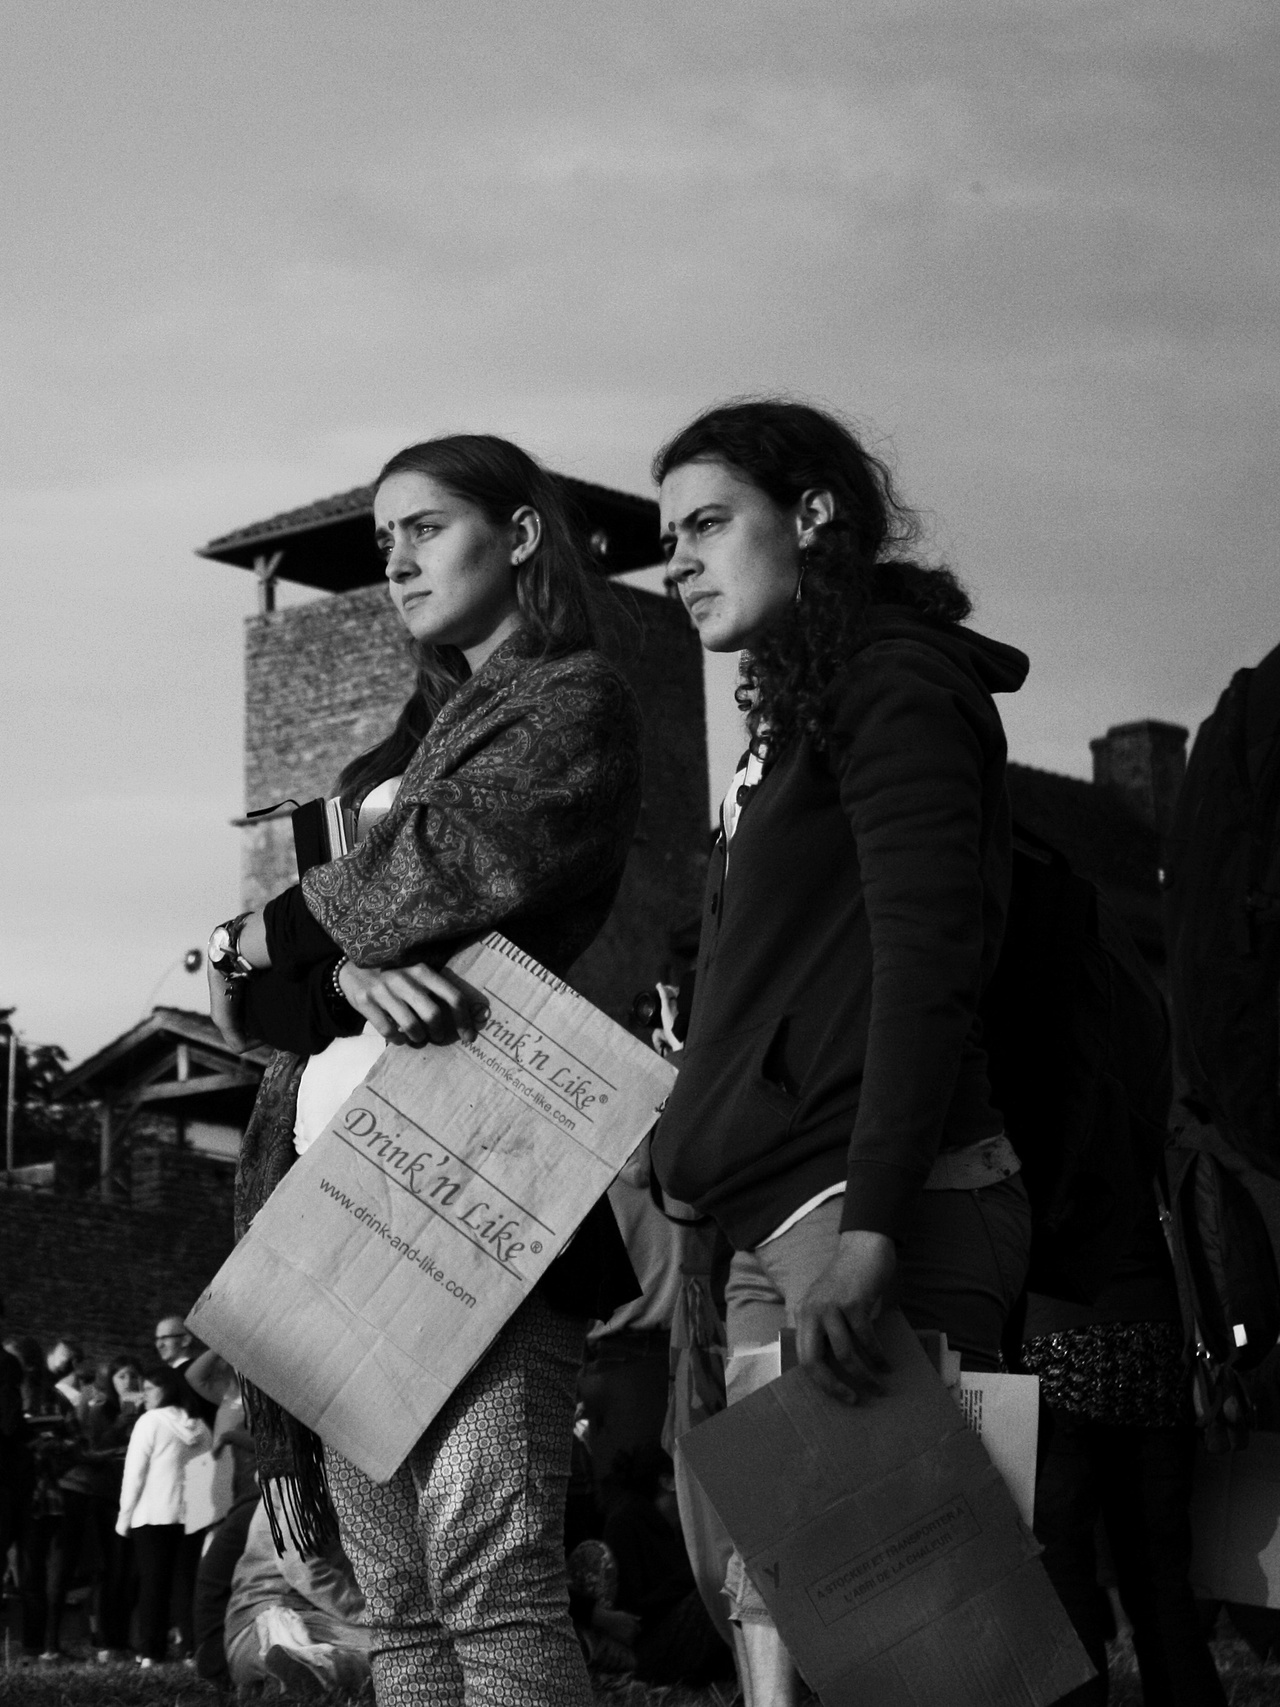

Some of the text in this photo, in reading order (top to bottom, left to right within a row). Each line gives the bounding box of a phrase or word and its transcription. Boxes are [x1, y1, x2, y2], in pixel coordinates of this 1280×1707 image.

[319, 1178, 478, 1309] www.drink-and-like.com
[825, 1561, 871, 1595] STOCKER
[870, 1552, 885, 1568] ET
[885, 1511, 958, 1557] TRANSPORTER
[876, 1569, 891, 1584] DE
[890, 1560, 906, 1575] LA
[905, 1532, 953, 1566] CHALEUR
